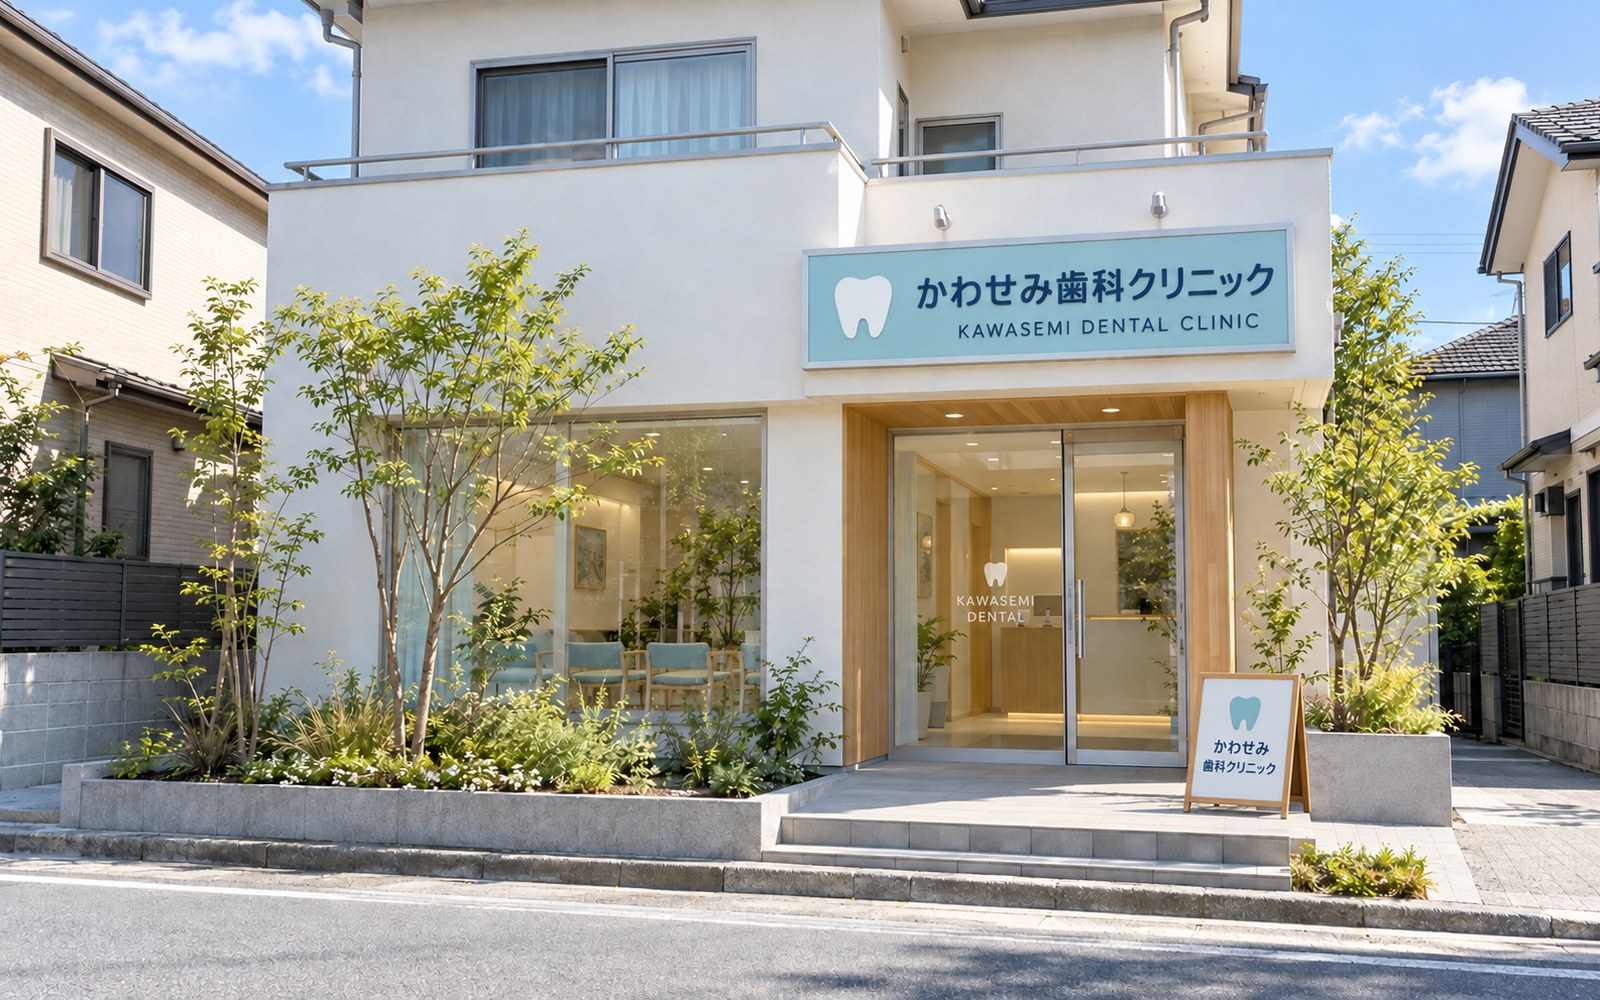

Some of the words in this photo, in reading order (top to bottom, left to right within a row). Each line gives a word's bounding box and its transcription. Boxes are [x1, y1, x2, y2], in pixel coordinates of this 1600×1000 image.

[917, 263, 1274, 309] かわせみ歯科クリニック
[958, 320, 1070, 339] KAWASEMI
[1081, 316, 1169, 335] DENTAL
[1180, 312, 1259, 331] CLINIC
[956, 595, 1034, 607] KAWASEMI
[967, 611, 1025, 623] DENTAL
[1213, 739, 1270, 756] かわせみ
[1202, 759, 1276, 775] 歯科クリニック
